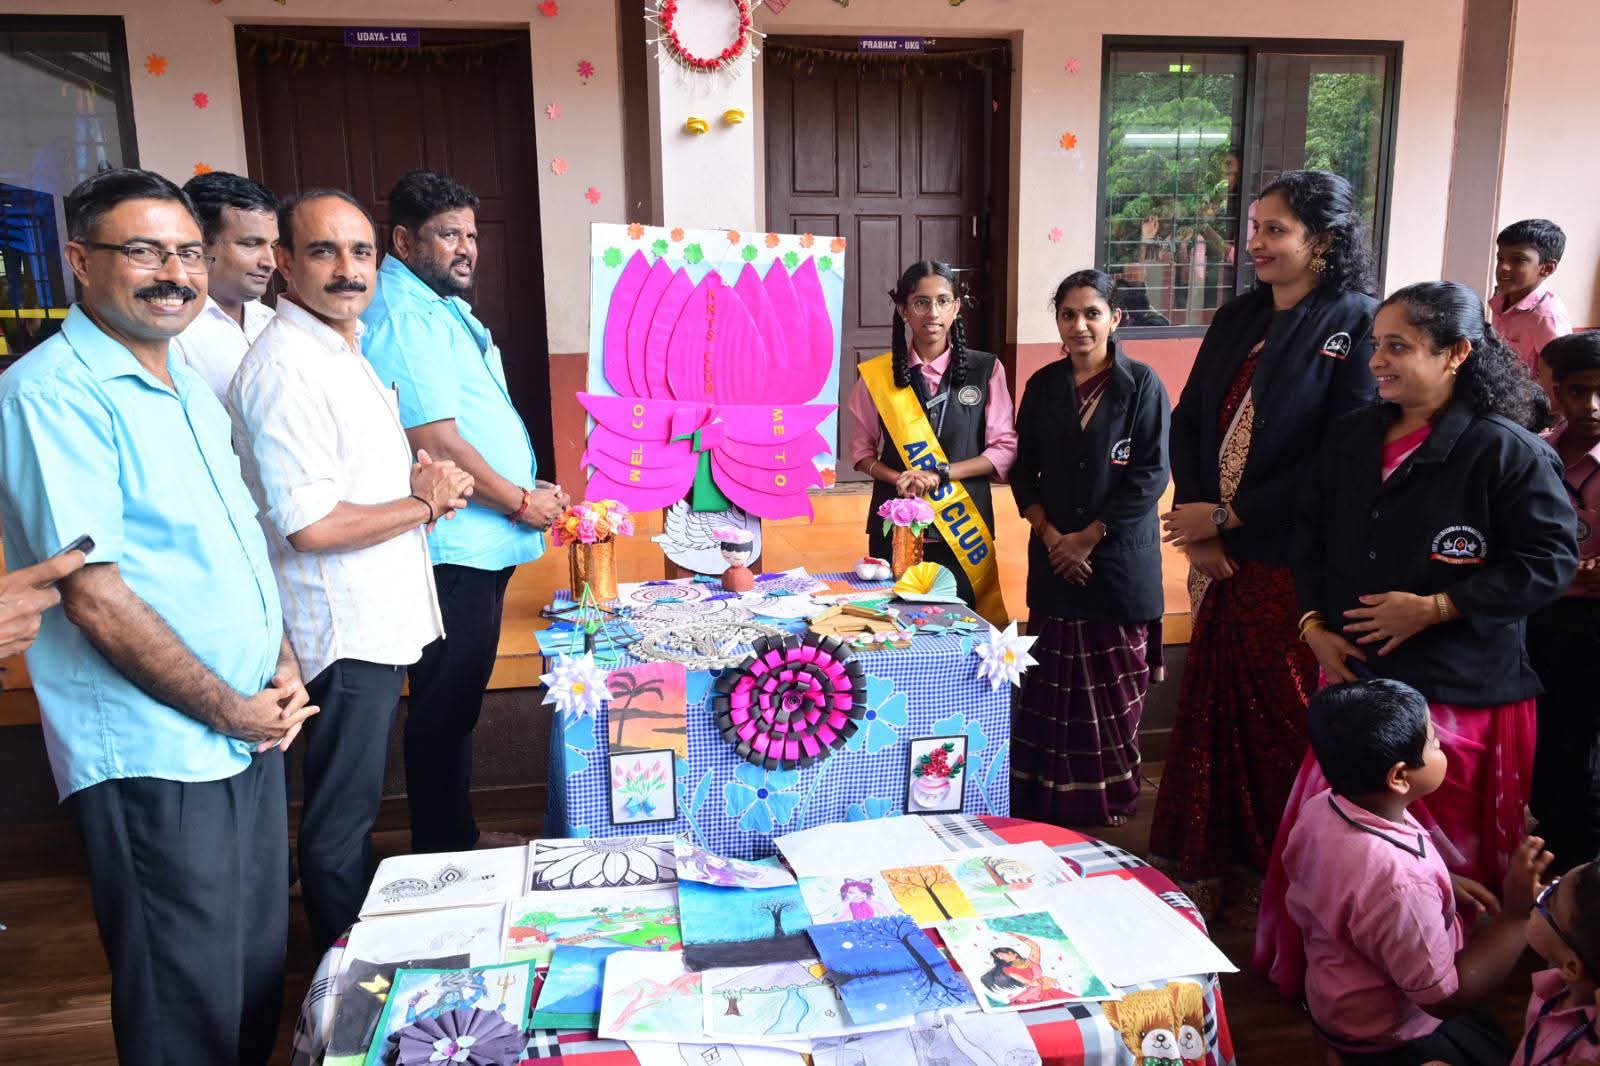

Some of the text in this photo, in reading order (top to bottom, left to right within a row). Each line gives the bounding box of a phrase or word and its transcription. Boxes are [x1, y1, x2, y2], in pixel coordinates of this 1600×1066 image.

[391, 32, 407, 41] LKG
[863, 41, 897, 49] PRABHAT
[905, 41, 920, 50] UKG
[903, 440, 953, 501] ARS
[941, 501, 989, 566] CLUB
